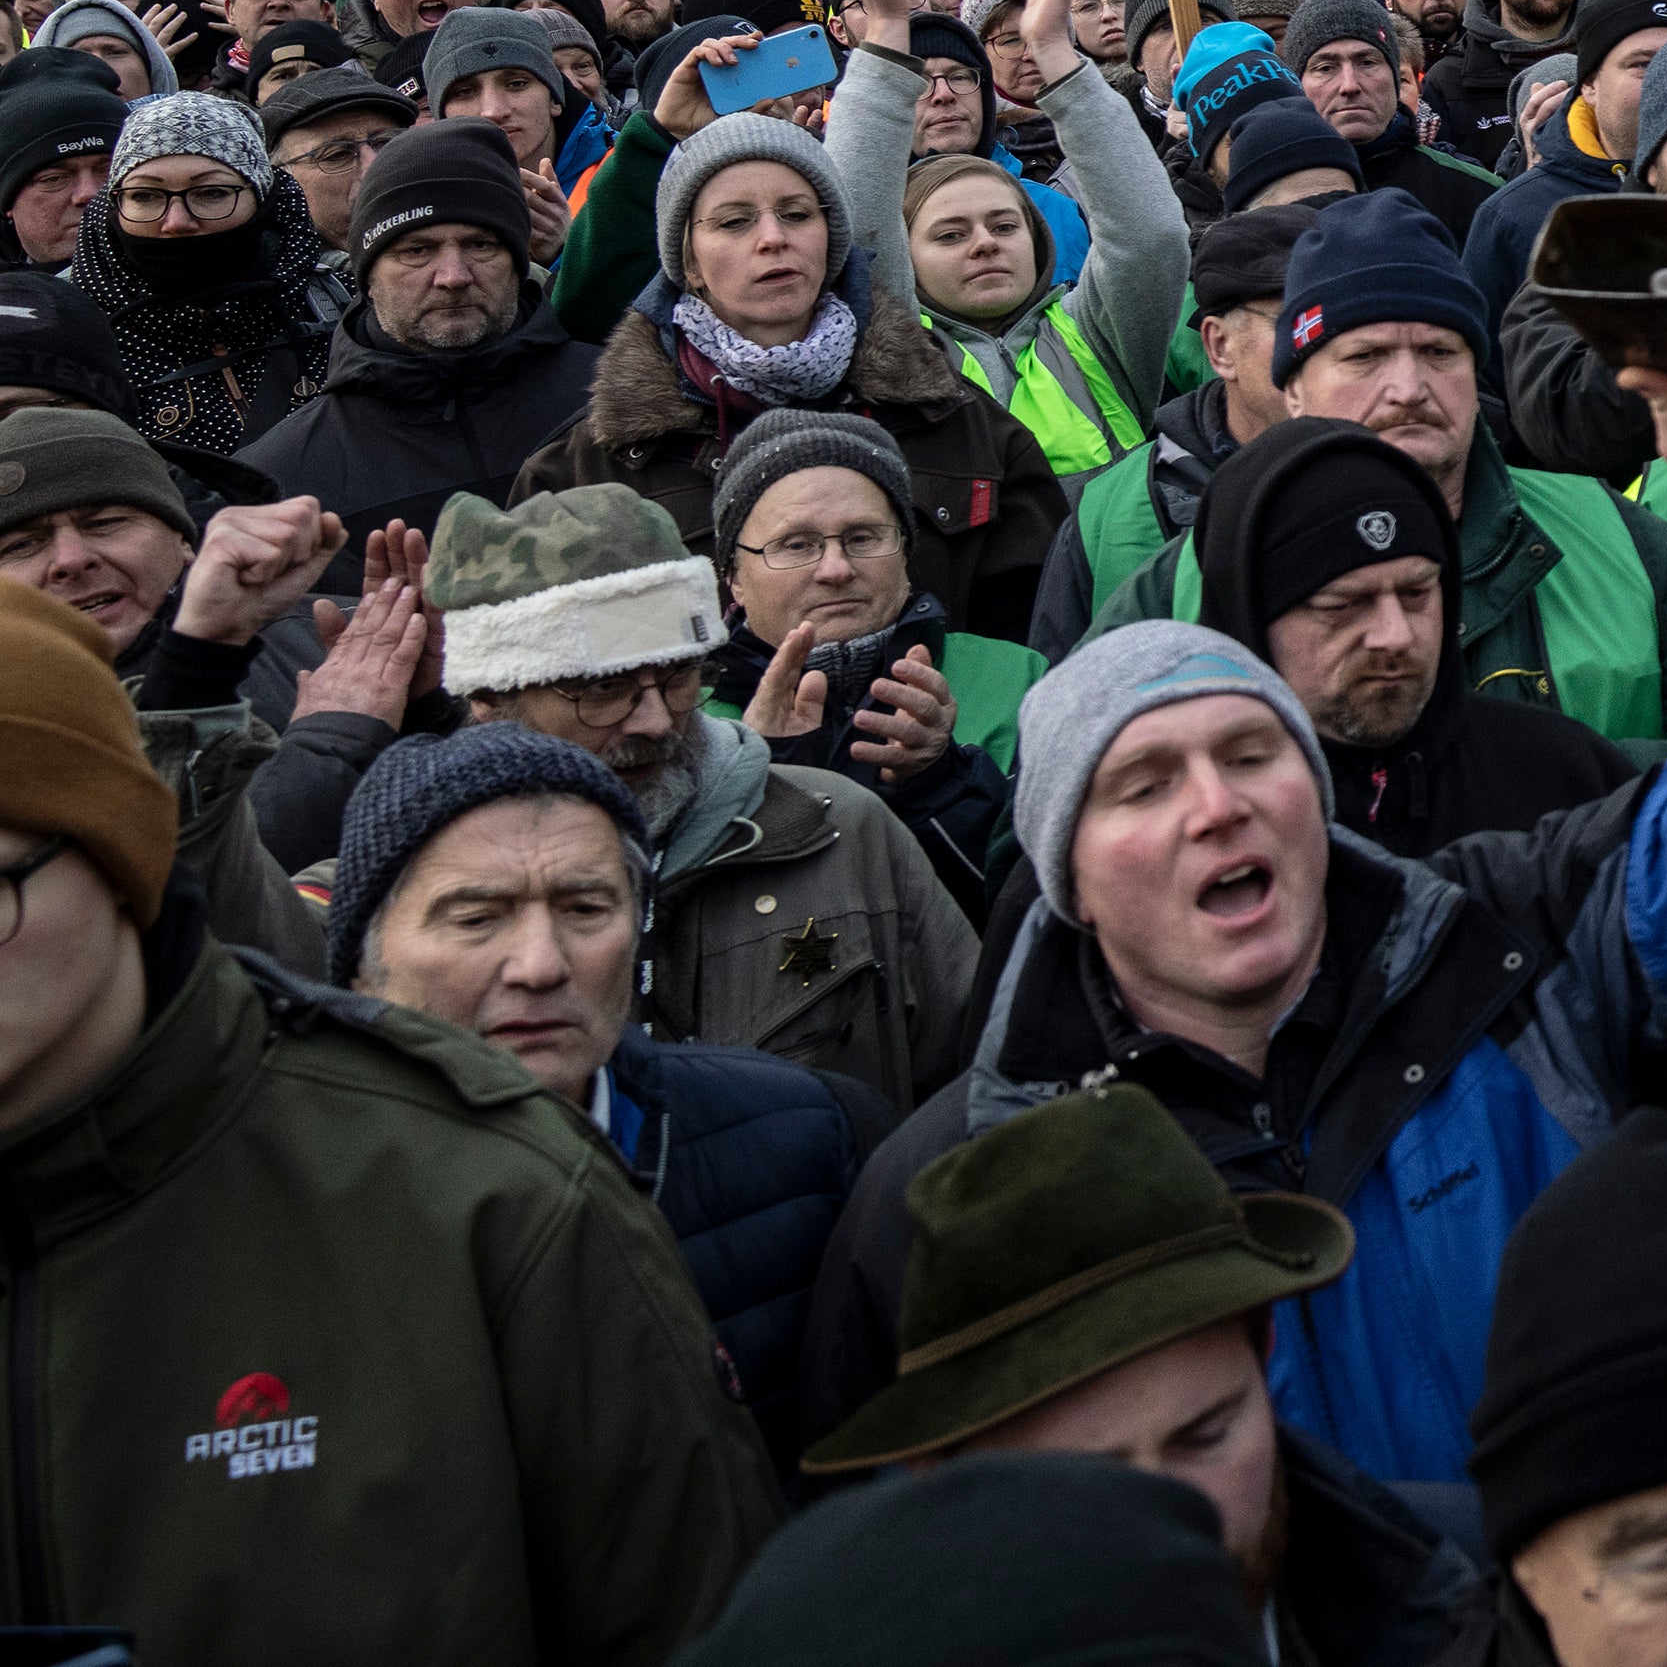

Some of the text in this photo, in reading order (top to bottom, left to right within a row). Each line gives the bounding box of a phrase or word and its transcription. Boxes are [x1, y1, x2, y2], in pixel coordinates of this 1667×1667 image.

[57, 136, 105, 154] BayWa
[373, 204, 434, 238] KÖCKERLING
[186, 1416, 319, 1462] ARCTIC
[229, 1439, 317, 1480] SEVEN
